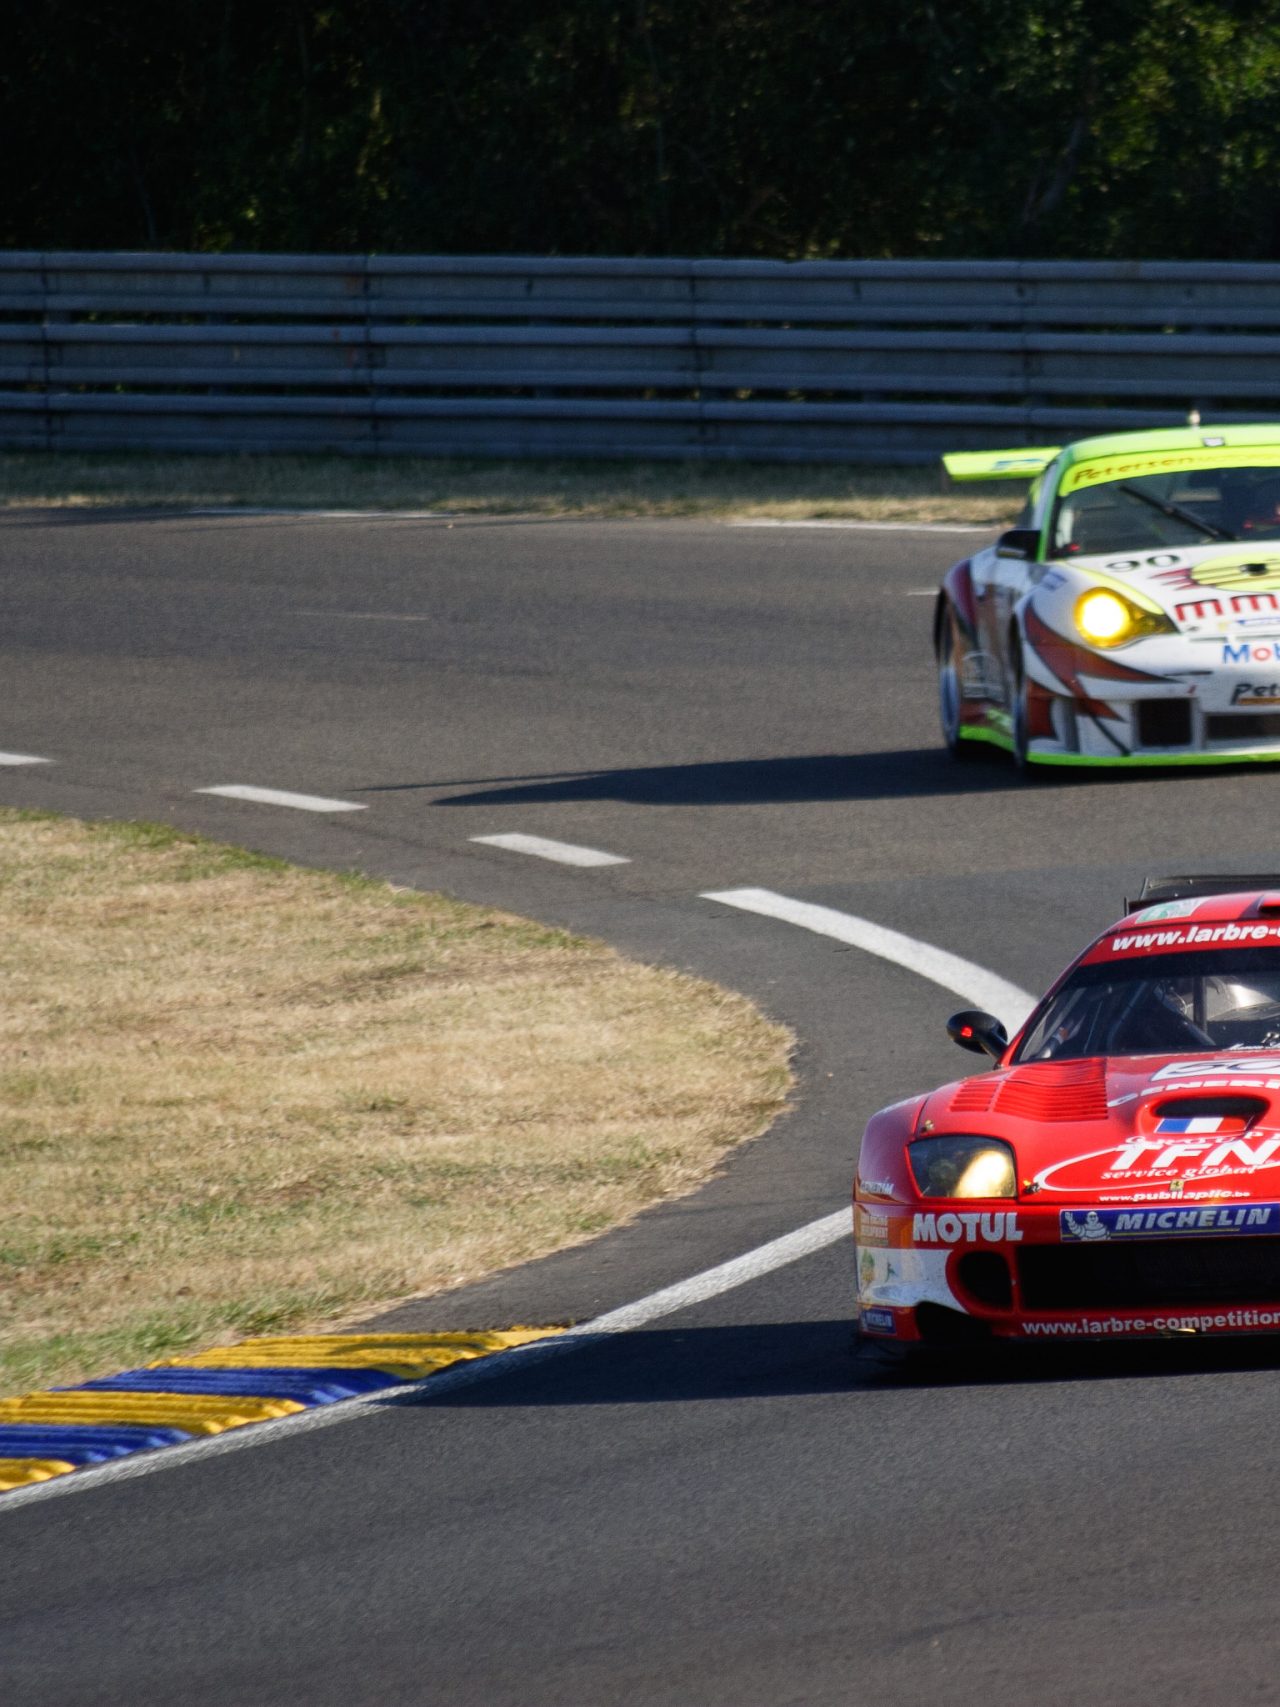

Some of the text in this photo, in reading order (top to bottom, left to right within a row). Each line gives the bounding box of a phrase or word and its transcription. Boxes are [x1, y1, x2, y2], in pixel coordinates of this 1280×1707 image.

[1106, 554, 1181, 572] 90
[1101, 1163, 1257, 1179] service global
[912, 1212, 1024, 1243] MOTUL
[1115, 1207, 1272, 1231] MICHELIN
